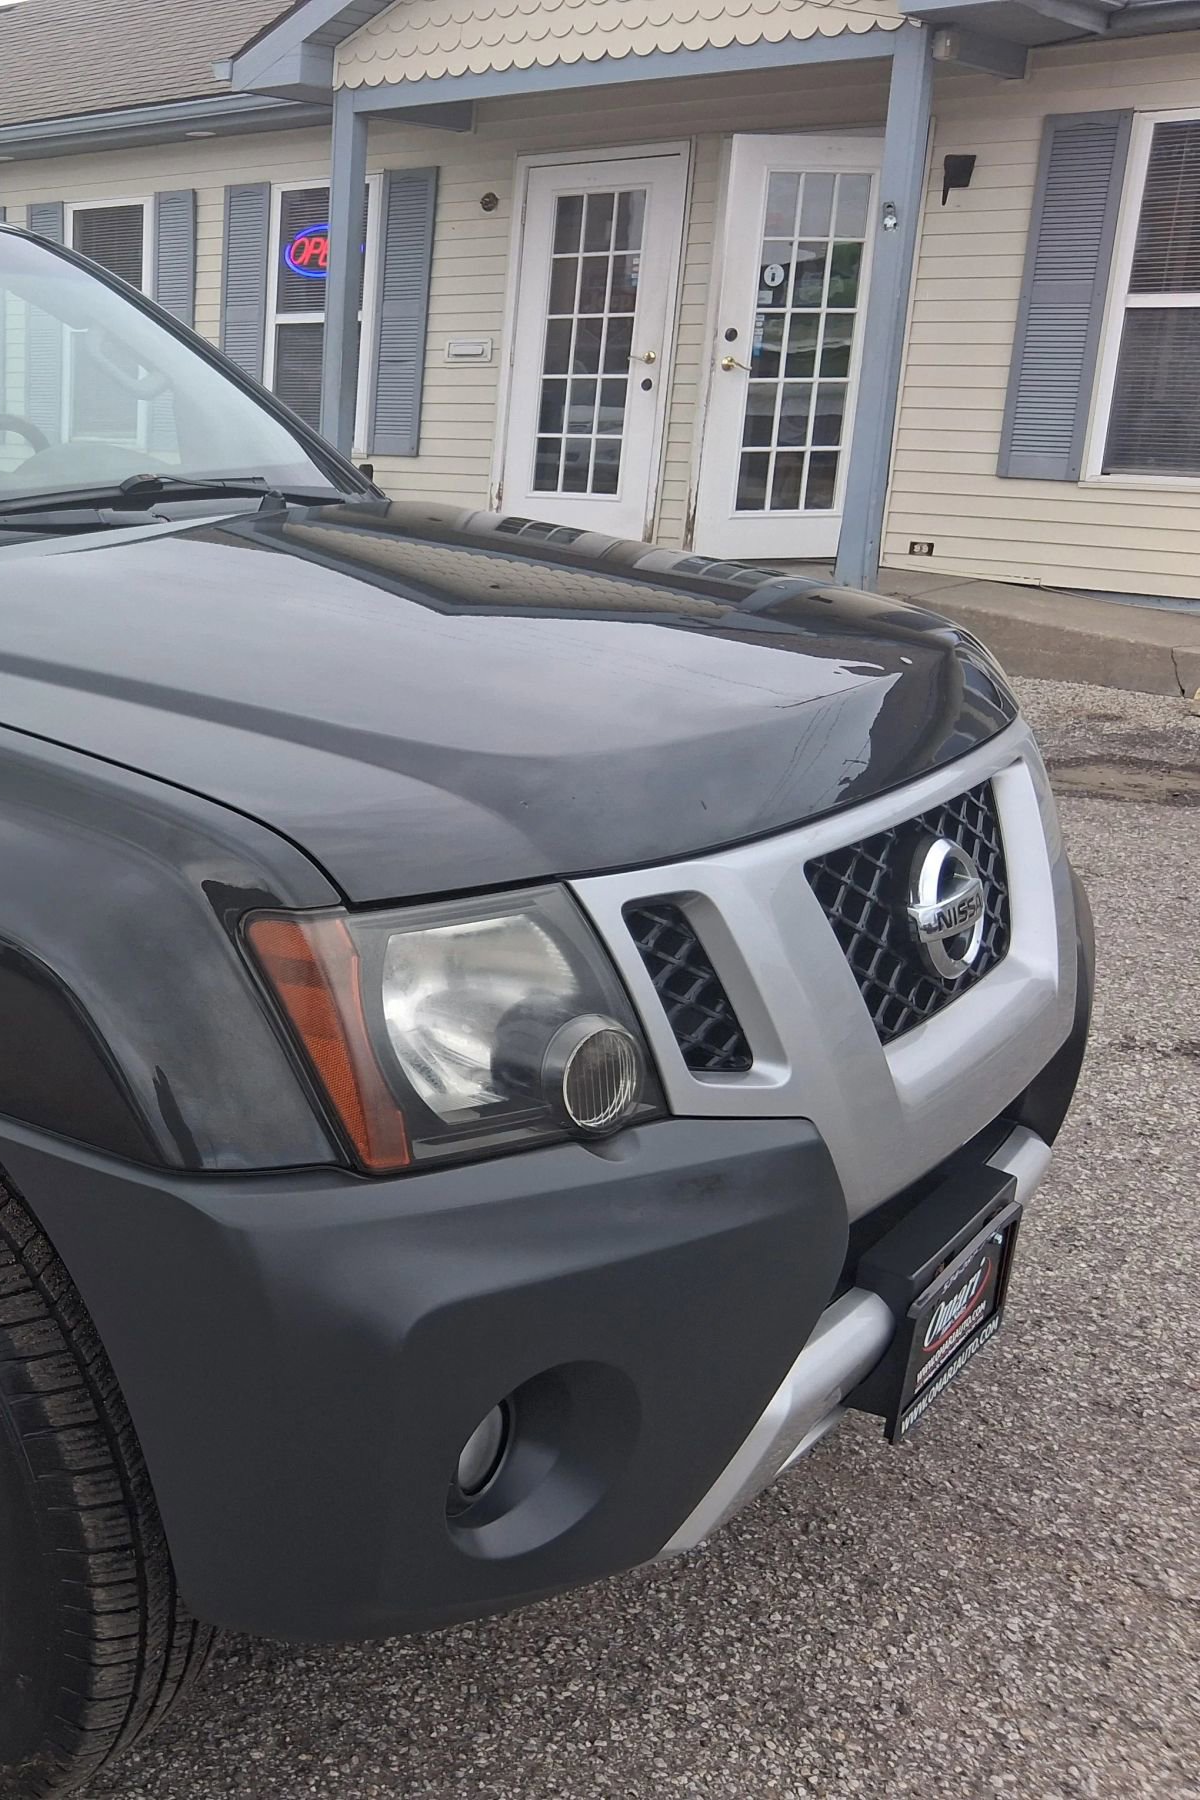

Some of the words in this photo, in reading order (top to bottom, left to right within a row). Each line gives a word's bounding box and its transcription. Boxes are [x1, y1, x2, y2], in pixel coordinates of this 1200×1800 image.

[290, 237, 330, 267] OPE
[936, 892, 982, 931] NISSA
[901, 1316, 999, 1434] WWW.OMARIAUTO.COM
